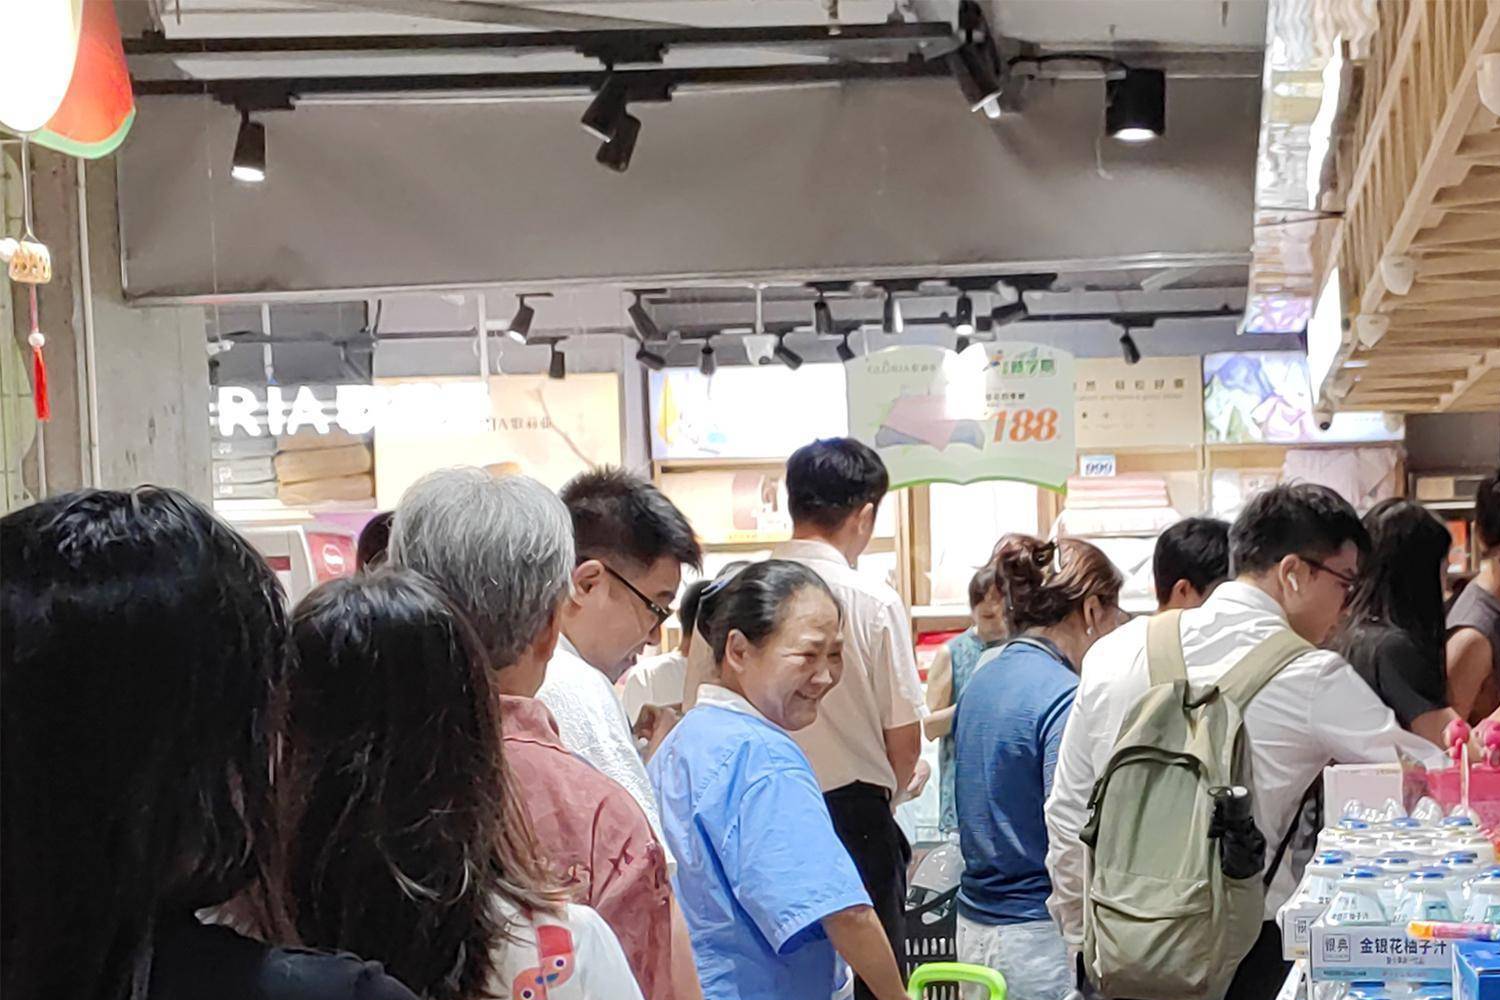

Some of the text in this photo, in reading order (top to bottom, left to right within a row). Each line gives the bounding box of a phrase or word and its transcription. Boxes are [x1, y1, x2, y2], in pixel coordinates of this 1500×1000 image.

[209, 386, 330, 436] RIA
[993, 408, 1058, 444] 188
[1360, 937, 1447, 956] 金银花柚子汁
